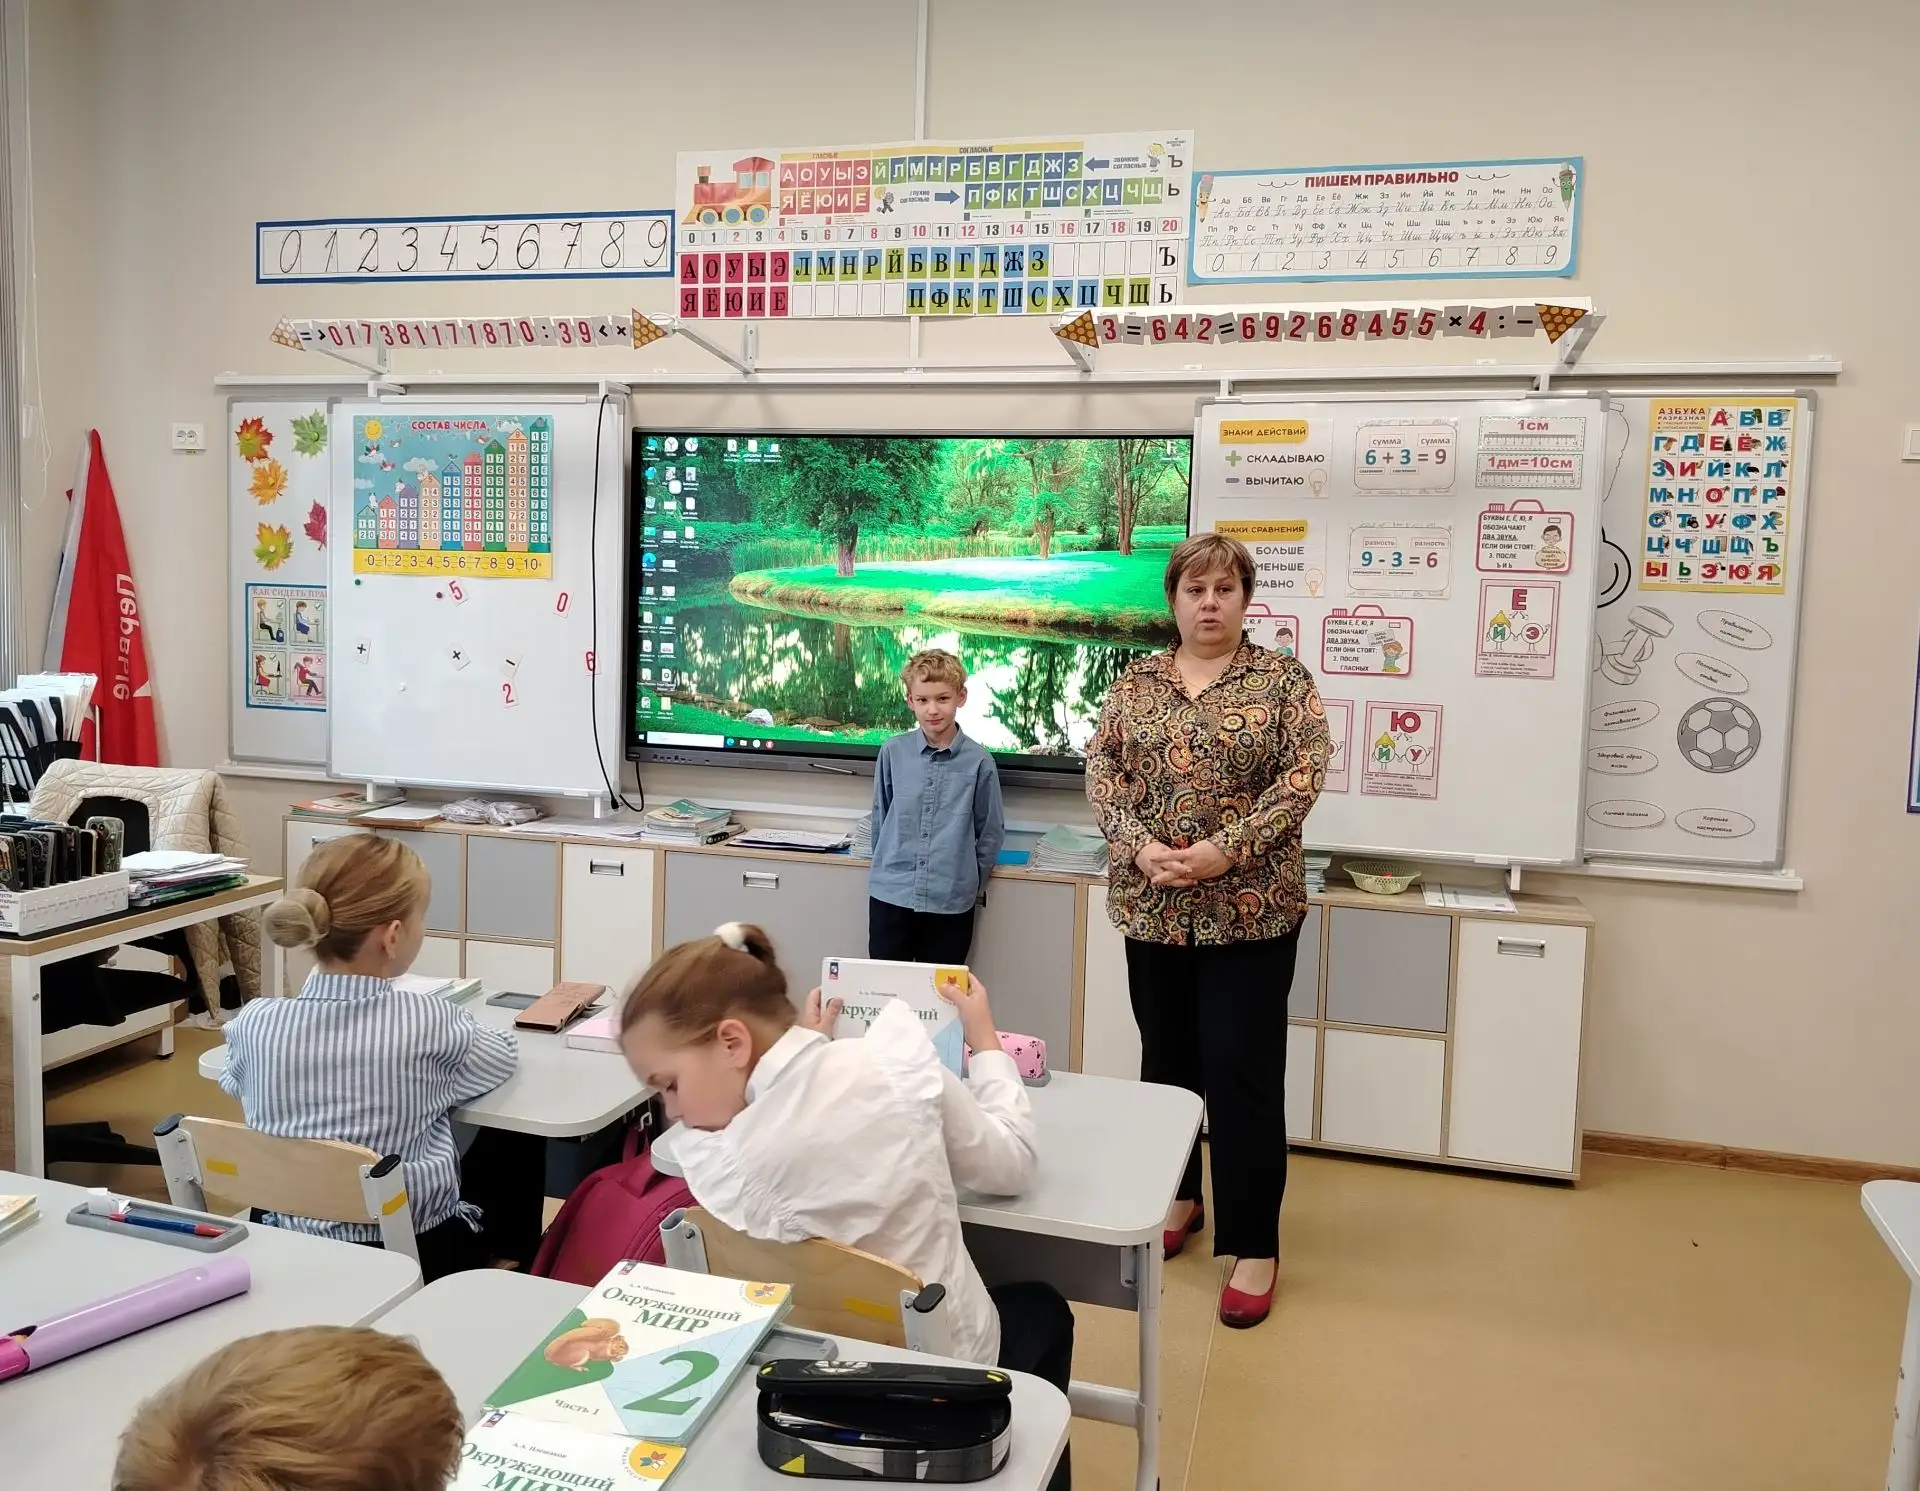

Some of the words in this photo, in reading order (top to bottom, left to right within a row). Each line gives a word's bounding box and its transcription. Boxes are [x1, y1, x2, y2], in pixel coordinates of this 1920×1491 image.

[1305, 175, 1361, 188] ПИШЕМ
[1365, 172, 1458, 185] ПРАВИЛЬНО
[683, 259, 696, 278] А
[706, 260, 718, 278] О
[728, 259, 741, 277] У
[748, 258, 765, 276] Ы
[775, 258, 786, 276] Э
[796, 257, 810, 276] Л
[818, 258, 833, 274] М
[843, 256, 856, 274] Н
[867, 255, 878, 274] Р
[888, 250, 902, 273] Й
[910, 254, 922, 272] Б
[935, 253, 947, 272] В
[959, 253, 971, 272] Г
[981, 253, 996, 277] Д
[1004, 251, 1023, 271] Ж
[1032, 251, 1044, 271] З
[1159, 247, 1175, 266] Ъ
[683, 294, 696, 311] Я
[707, 290, 717, 312] Ё
[725, 292, 742, 311] Ю
[750, 293, 765, 310] И
[774, 292, 785, 310] Е
[908, 289, 924, 307] П
[931, 288, 949, 307] Ф
[956, 289, 970, 307] К
[982, 288, 995, 307] Т
[1004, 288, 1022, 307] Ш
[1032, 287, 1043, 306] С
[1055, 287, 1071, 306] Х
[1080, 286, 1096, 307] Ц
[1107, 285, 1121, 304] Ч
[1129, 284, 1149, 305] Щ
[1160, 284, 1172, 303] Ь
[412, 421, 449, 429] СОСТАВ
[454, 421, 486, 429] ЧИСЛА
[1257, 427, 1306, 436] ДЕЙСТВИЙ
[1518, 420, 1548, 430] 1см
[1247, 455, 1324, 463] СКЛАДЫВАЮ
[1366, 450, 1376, 465] 6
[1400, 449, 1410, 464] 3
[1435, 449, 1446, 464] 9
[1488, 457, 1572, 469] 1дм=10см
[1246, 477, 1304, 485] ВЫЧИТАЮ
[368, 555, 374, 565] 0
[383, 555, 387, 566] 1
[395, 555, 401, 566] 2
[411, 555, 417, 566] 3
[427, 555, 433, 566] 4
[443, 555, 449, 567] 5
[459, 555, 465, 567] 6
[475, 556, 481, 567] 7
[490, 556, 497, 568] 8
[507, 557, 514, 569] 9
[525, 558, 538, 570] 10
[1256, 563, 1304, 571] МЕНЬШЕ
[1362, 551, 1372, 566] 9
[1392, 552, 1402, 567] 3
[1427, 552, 1437, 568] 6
[449, 581, 463, 600] 5
[1256, 580, 1294, 588] РАВНО
[1512, 589, 1527, 610] Е
[1526, 627, 1539, 639] Э
[503, 683, 514, 703] 2
[1391, 711, 1421, 733] Ю
[1410, 749, 1422, 761] У
[826, 998, 938, 1020] кружий
[602, 1286, 742, 1321] Окружающий
[632, 1309, 710, 1333] МИР
[622, 1350, 720, 1415] 2
[555, 1399, 589, 1413] Часть
[461, 1442, 616, 1491] Окружающий
